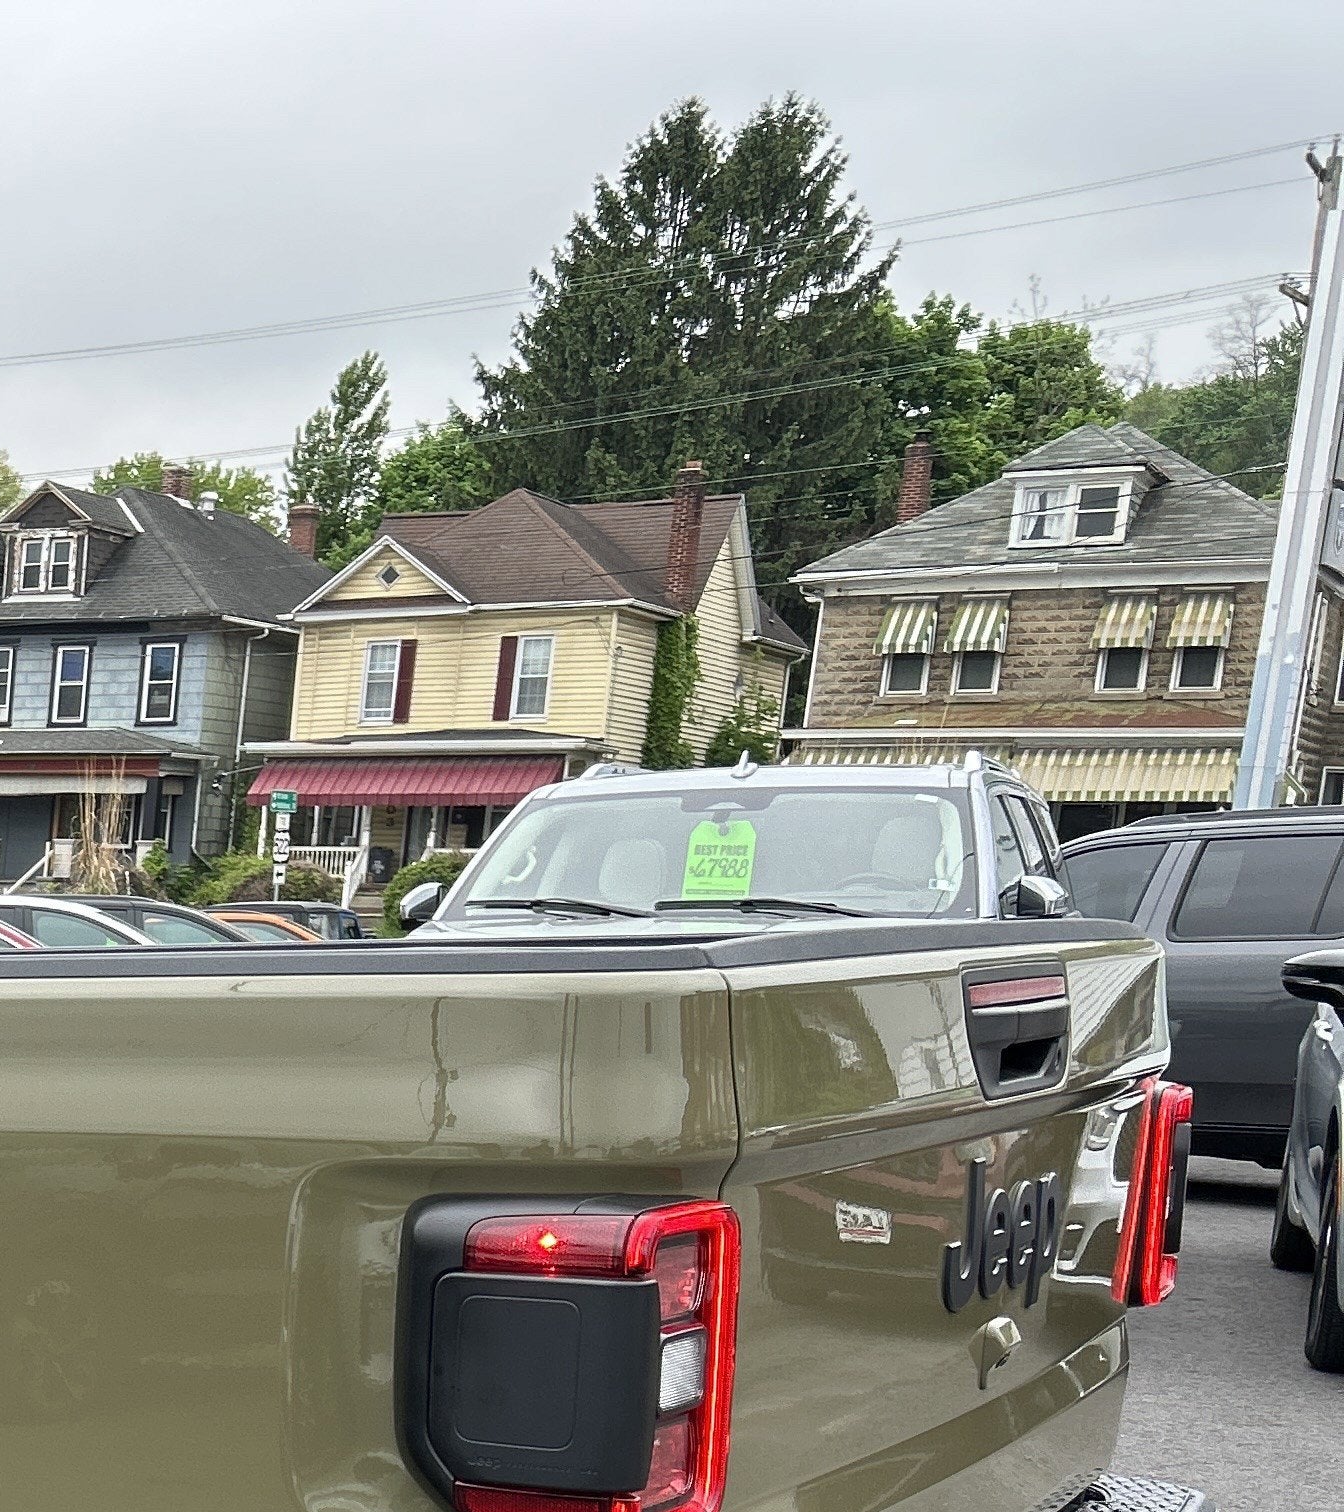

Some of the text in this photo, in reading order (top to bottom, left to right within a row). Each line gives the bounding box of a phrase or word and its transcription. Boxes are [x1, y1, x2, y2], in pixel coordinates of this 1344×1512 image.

[694, 844, 749, 857] BEST PRICE
[941, 1156, 1060, 1314] Jeep
